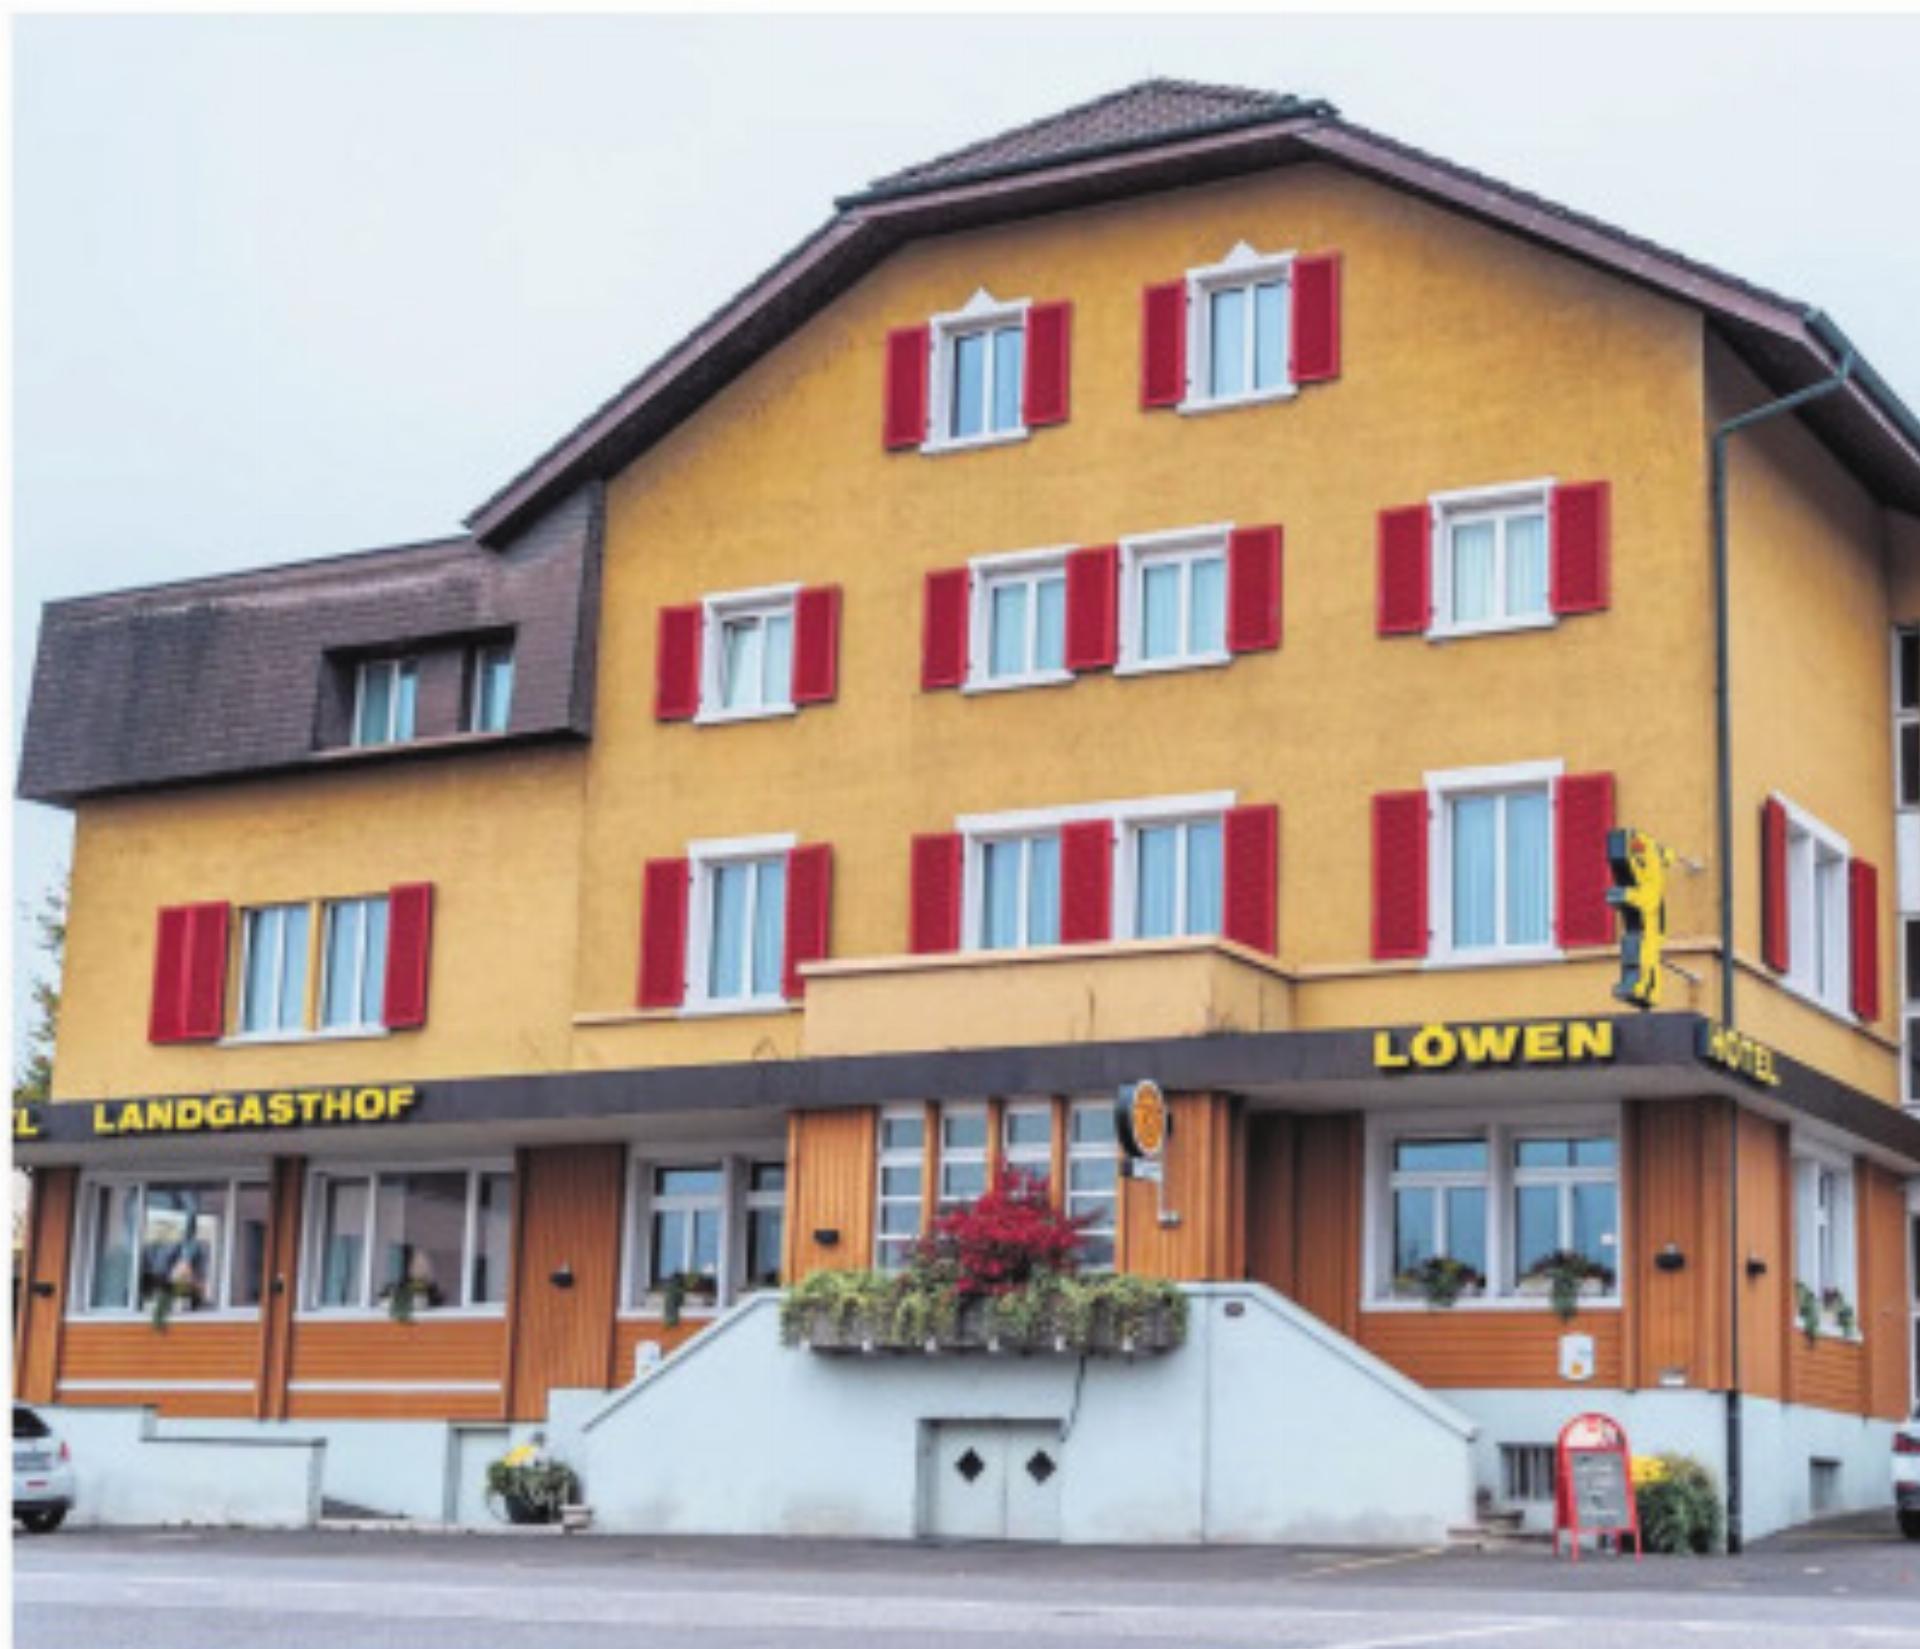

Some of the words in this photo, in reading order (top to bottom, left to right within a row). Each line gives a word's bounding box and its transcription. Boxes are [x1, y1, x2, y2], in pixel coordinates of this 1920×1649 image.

[1373, 1020, 1613, 1067] LÖWEN
[1708, 1026, 1781, 1086] HOTEL
[93, 1086, 415, 1135] LANDGASTHOF
